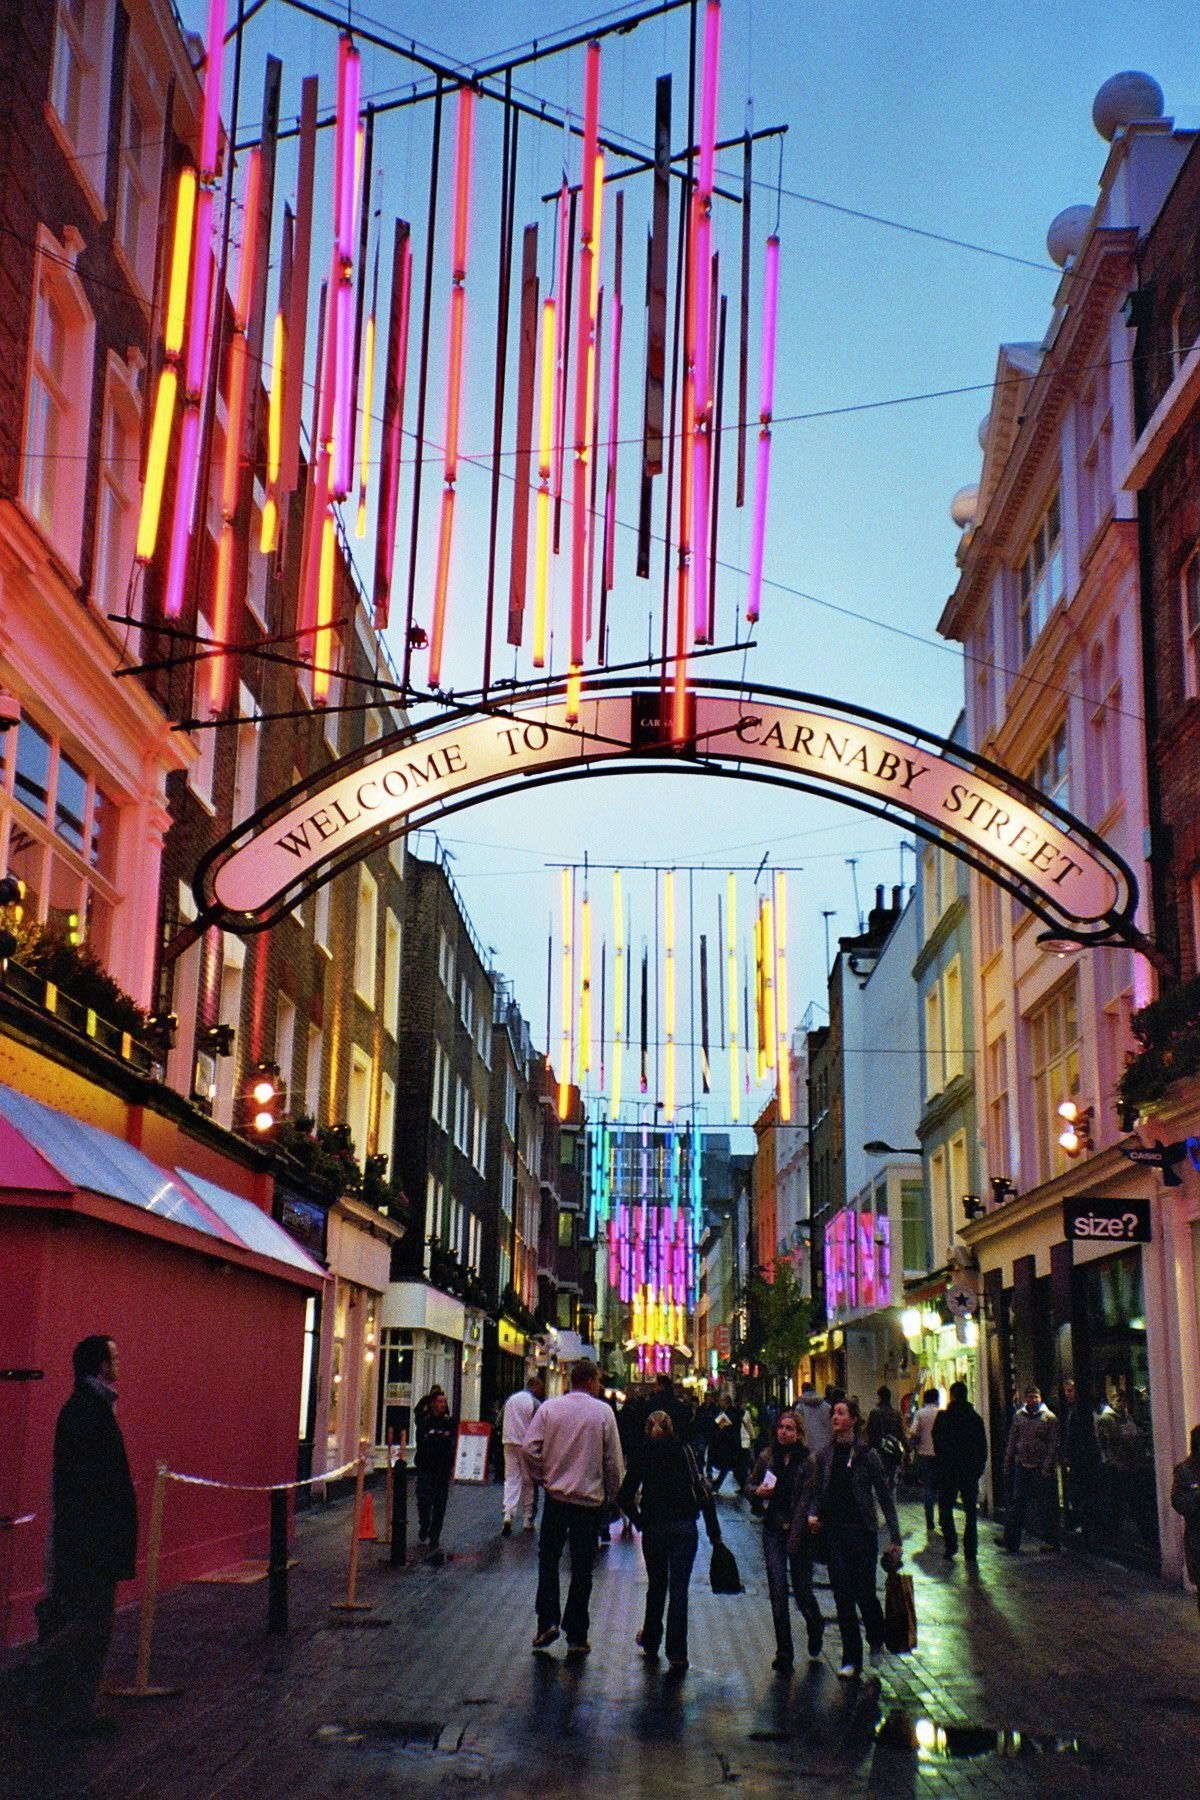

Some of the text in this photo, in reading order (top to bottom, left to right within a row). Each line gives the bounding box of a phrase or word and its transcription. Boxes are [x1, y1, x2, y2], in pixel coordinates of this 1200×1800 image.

[274, 716, 1084, 888] WELCOME TO CARNABY STREET
[1074, 1212, 1139, 1237] size?
